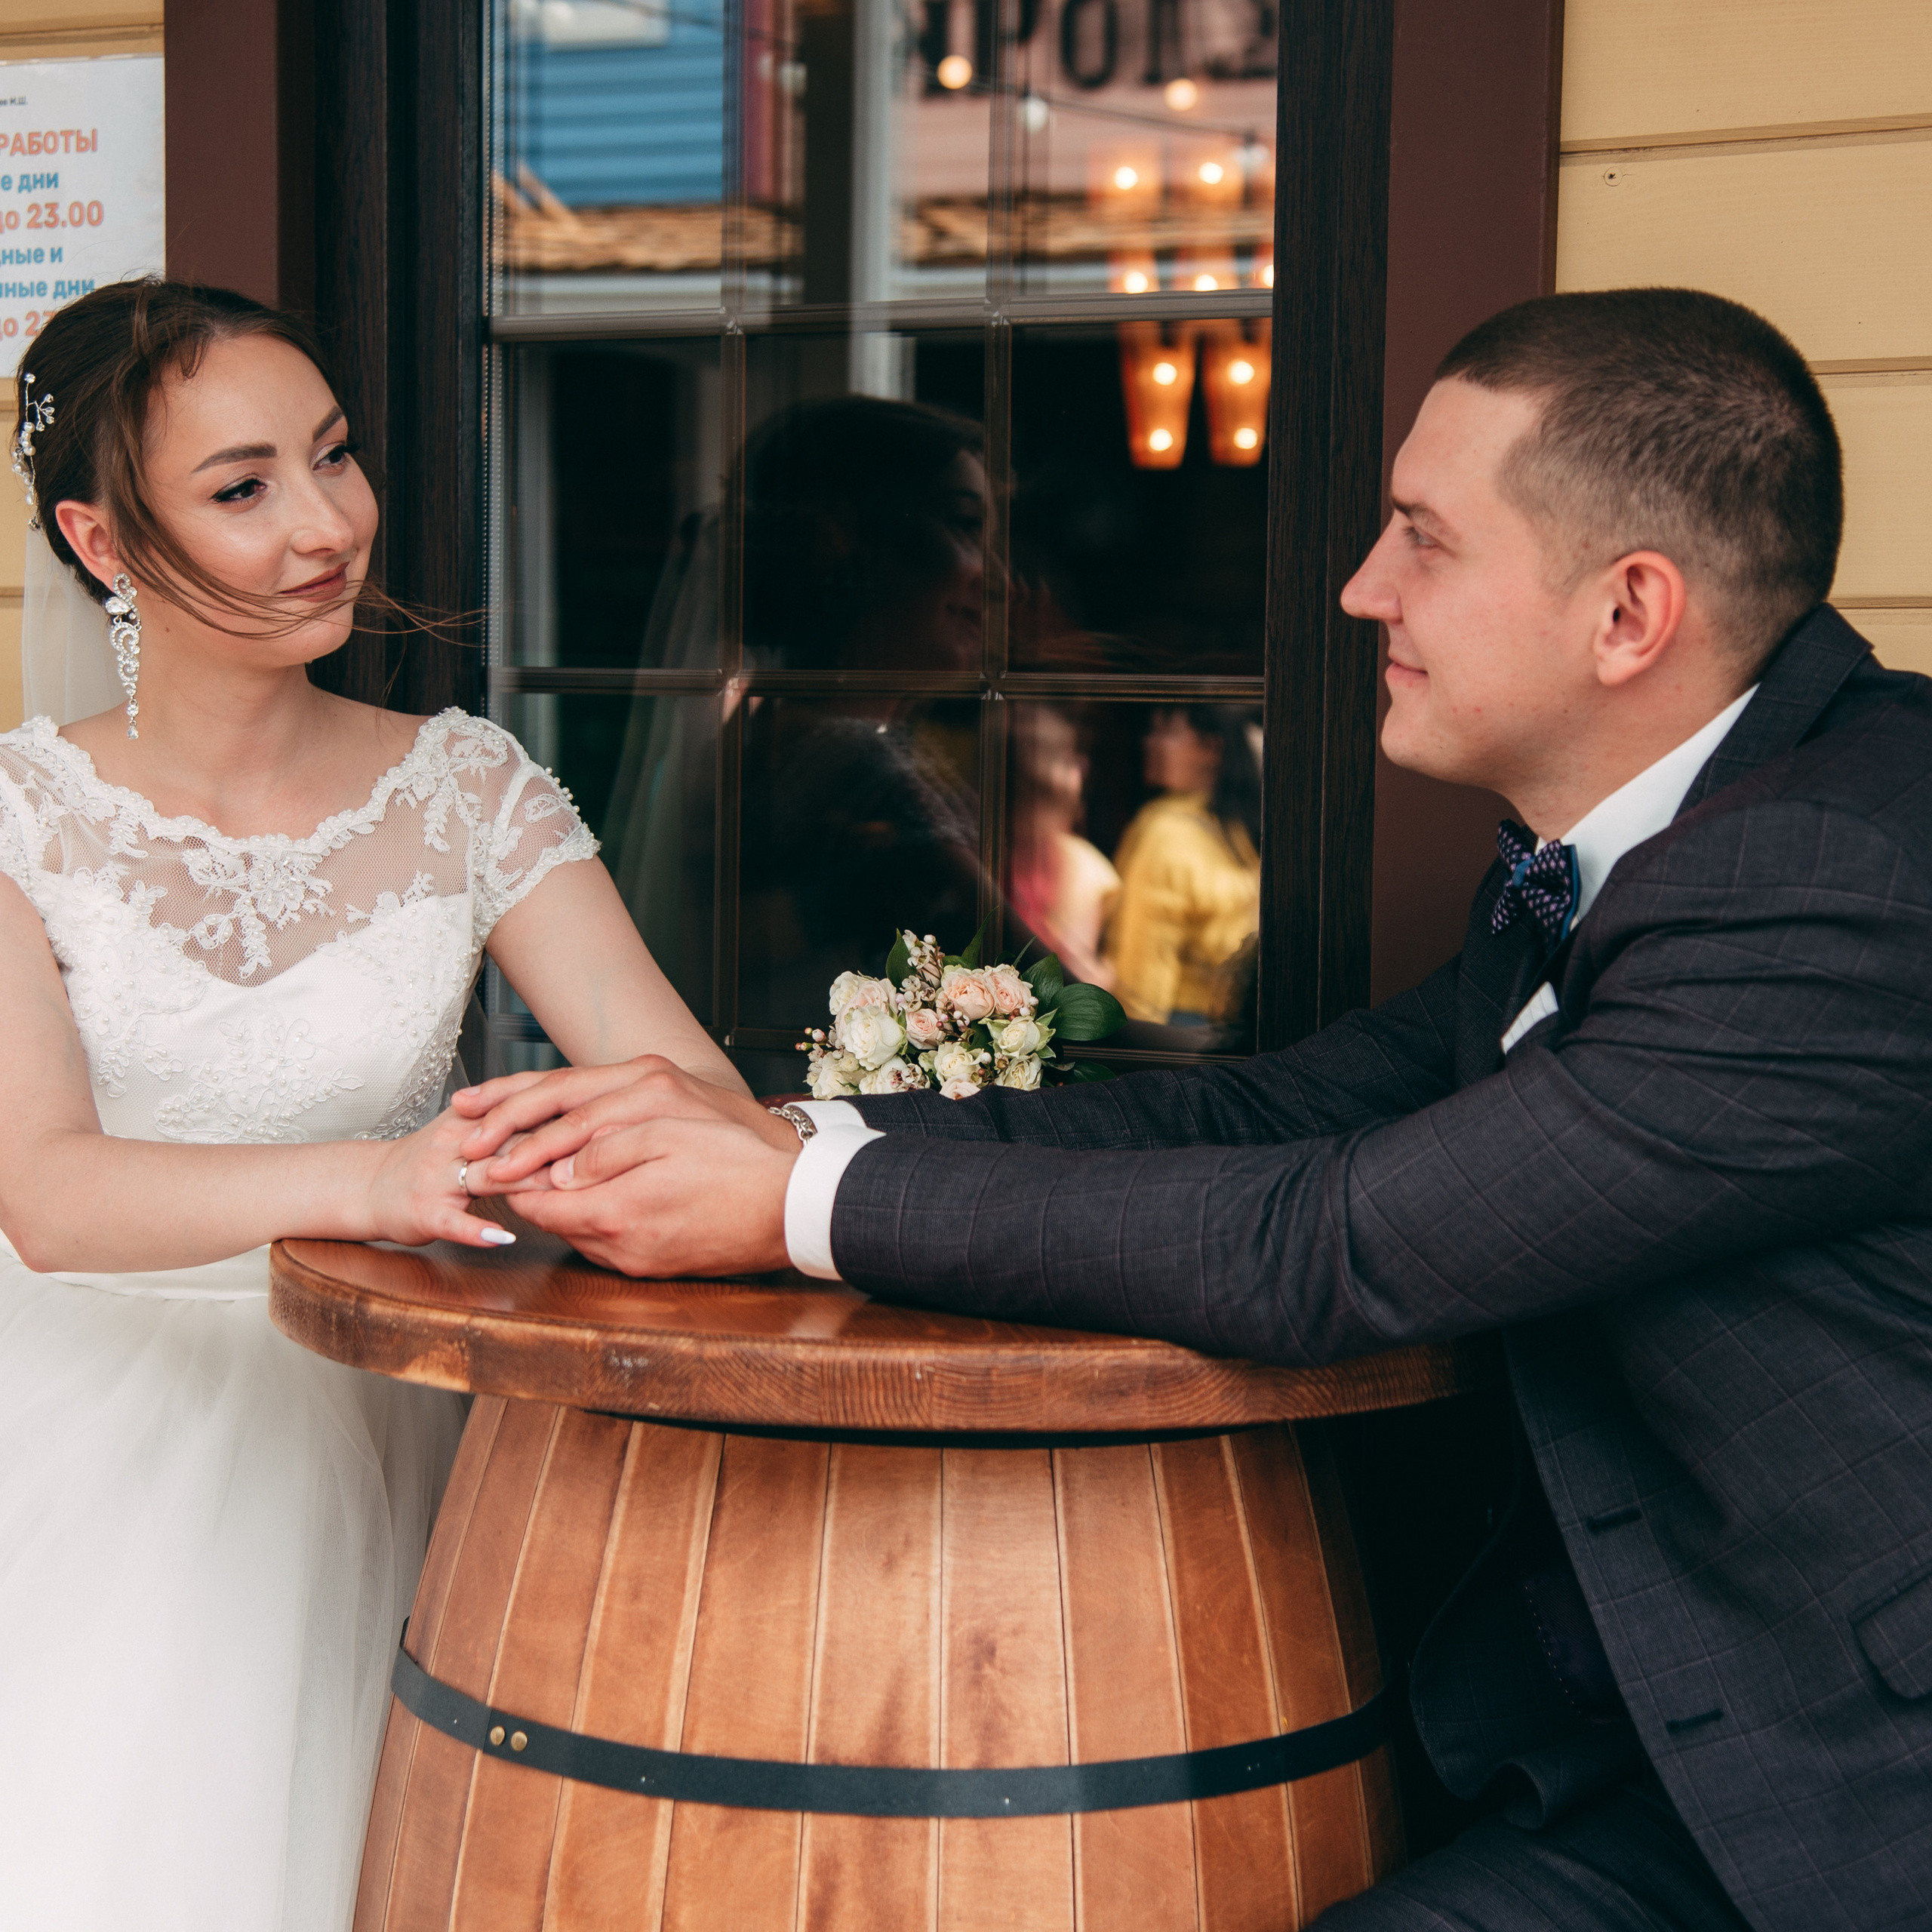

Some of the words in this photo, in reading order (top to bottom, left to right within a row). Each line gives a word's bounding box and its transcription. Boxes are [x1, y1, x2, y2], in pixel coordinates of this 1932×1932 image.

[0, 128, 98, 156] РАБОТЫ
[0, 174, 14, 191] е
[17, 172, 60, 193] дни
[26, 199, 104, 229] 23.00
[0, 247, 45, 268] ные
[50, 246, 63, 263] и
[53, 278, 95, 300] дни
[0, 317, 18, 341] о
